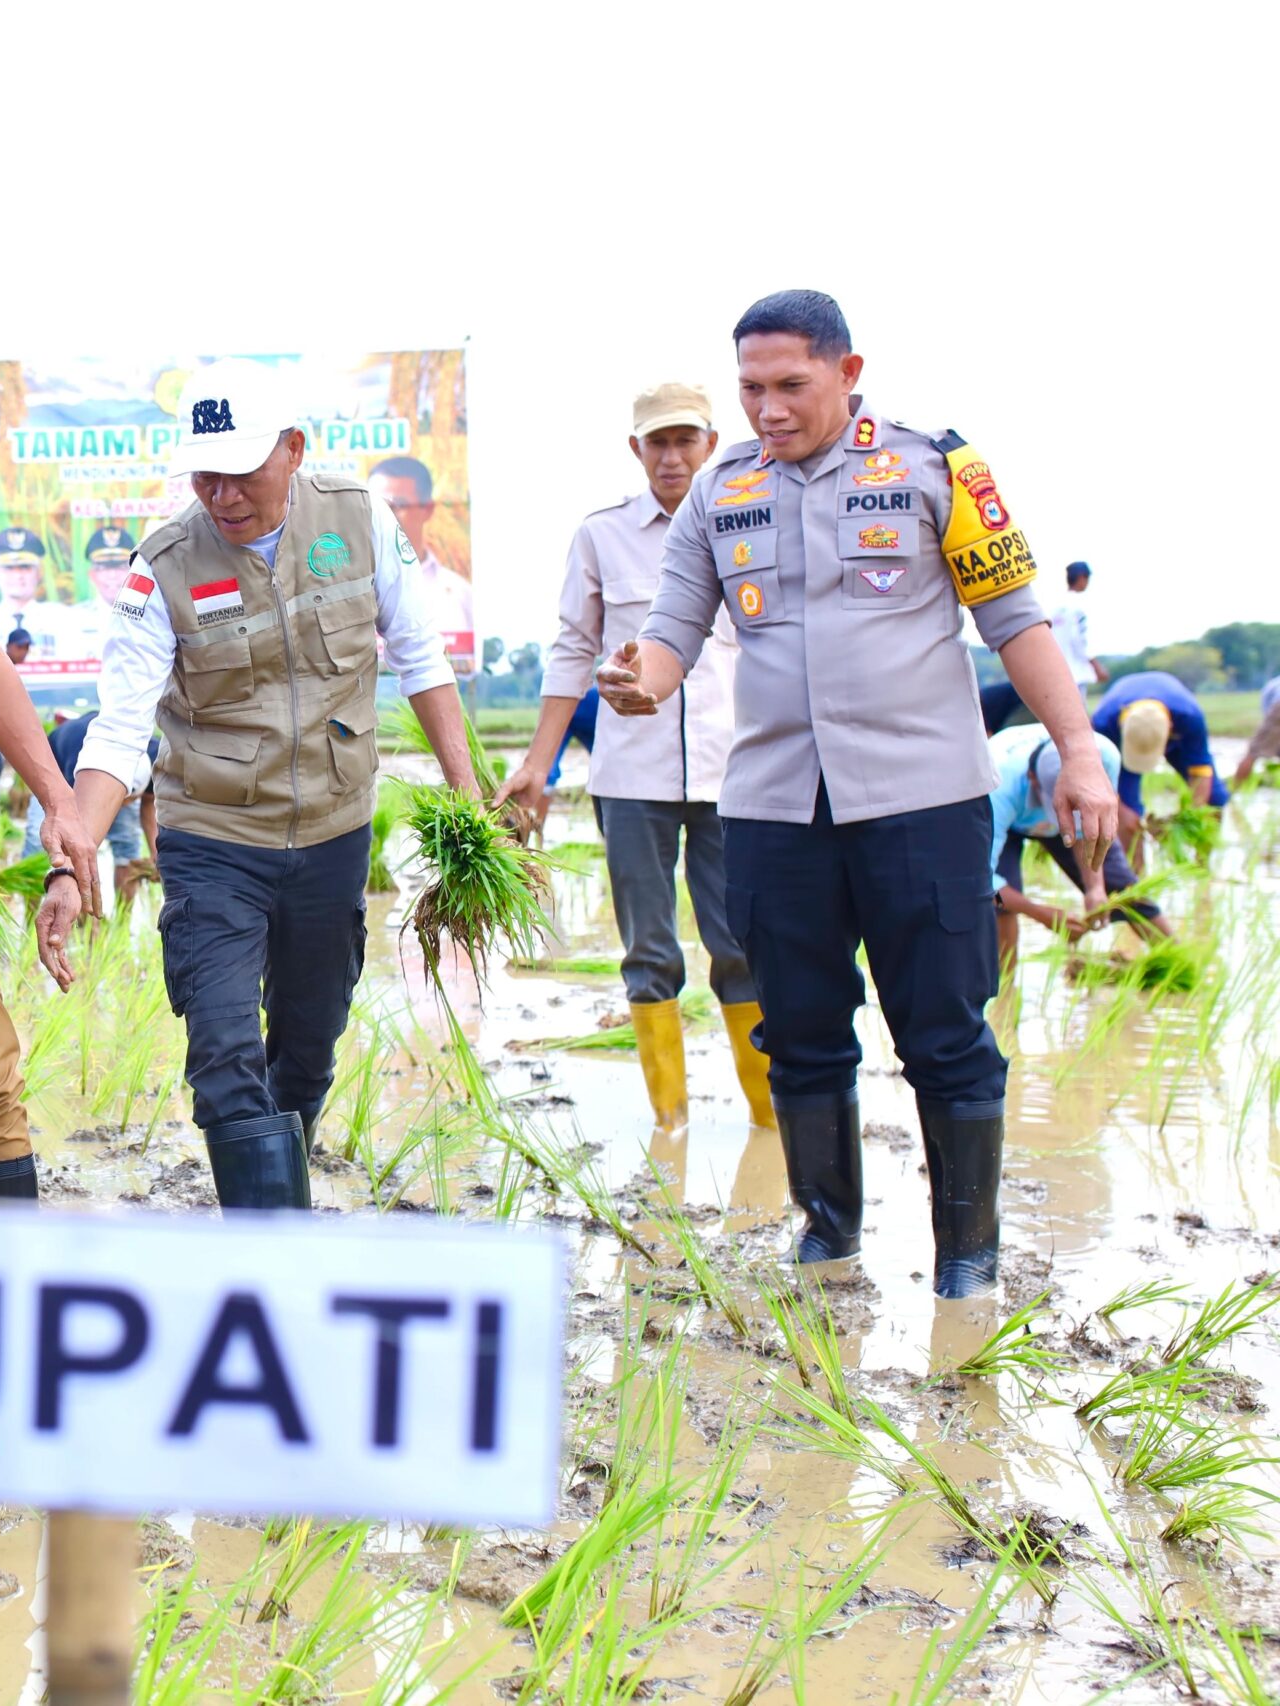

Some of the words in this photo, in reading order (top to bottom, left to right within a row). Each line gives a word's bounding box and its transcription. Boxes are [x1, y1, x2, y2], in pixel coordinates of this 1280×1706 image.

[13, 429, 135, 458] TANAM
[327, 423, 405, 450] PADI
[846, 492, 911, 512] POLRI
[714, 507, 771, 533] ERWIN
[952, 549, 986, 576] KA
[197, 605, 245, 621] PERTANIAN
